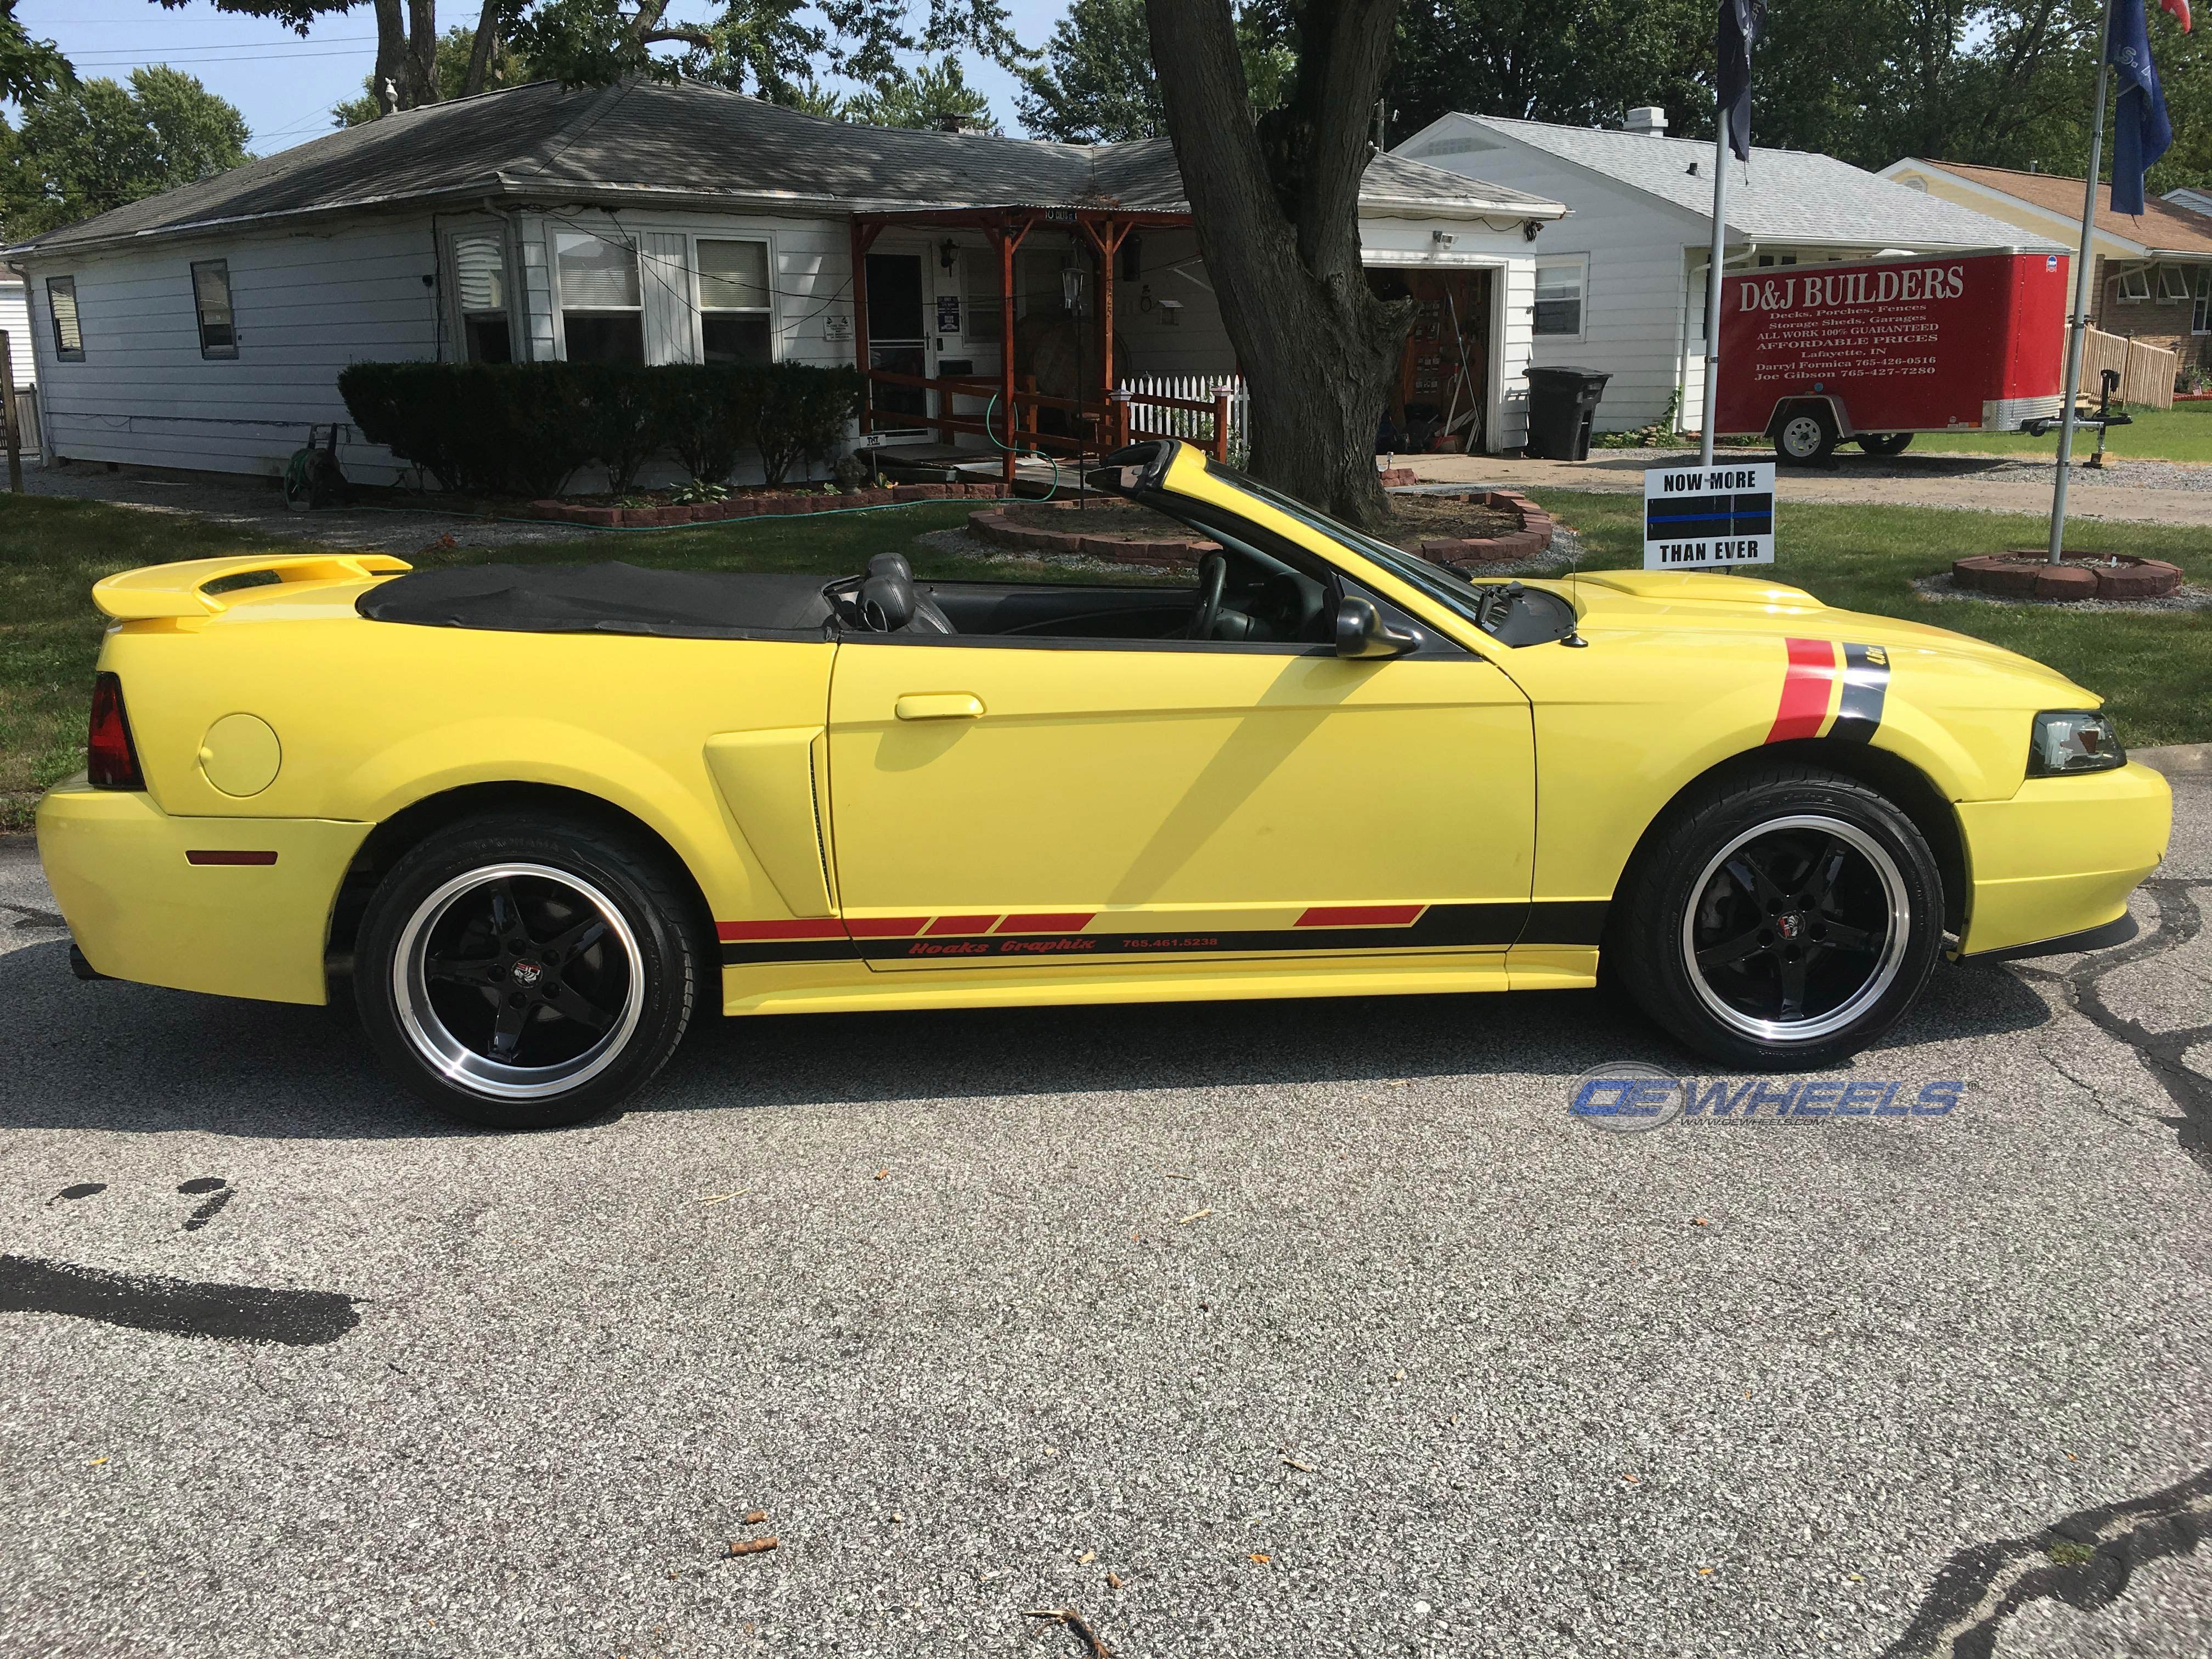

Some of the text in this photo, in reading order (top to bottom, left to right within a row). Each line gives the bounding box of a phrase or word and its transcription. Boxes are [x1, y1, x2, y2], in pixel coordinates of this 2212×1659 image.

[1739, 266, 1964, 312] D&J BUILDERS
[1878, 304, 1927, 313] Fences
[1769, 321, 1819, 329] Storage
[1870, 315, 1927, 323] Garages
[1782, 330, 1819, 338] WORK
[1850, 323, 1939, 335] GUARANTEED
[1757, 334, 1939, 351] AFFORDABLE PRICES
[1756, 357, 1937, 371] Darryl Formica 765-426-0516
[1841, 366, 1936, 377] 765-427-7280
[1664, 471, 1756, 492] NOW MORE
[1660, 540, 1758, 563] THAN EVER
[909, 938, 1218, 954] Hoaks Graphix 765.461.5238
